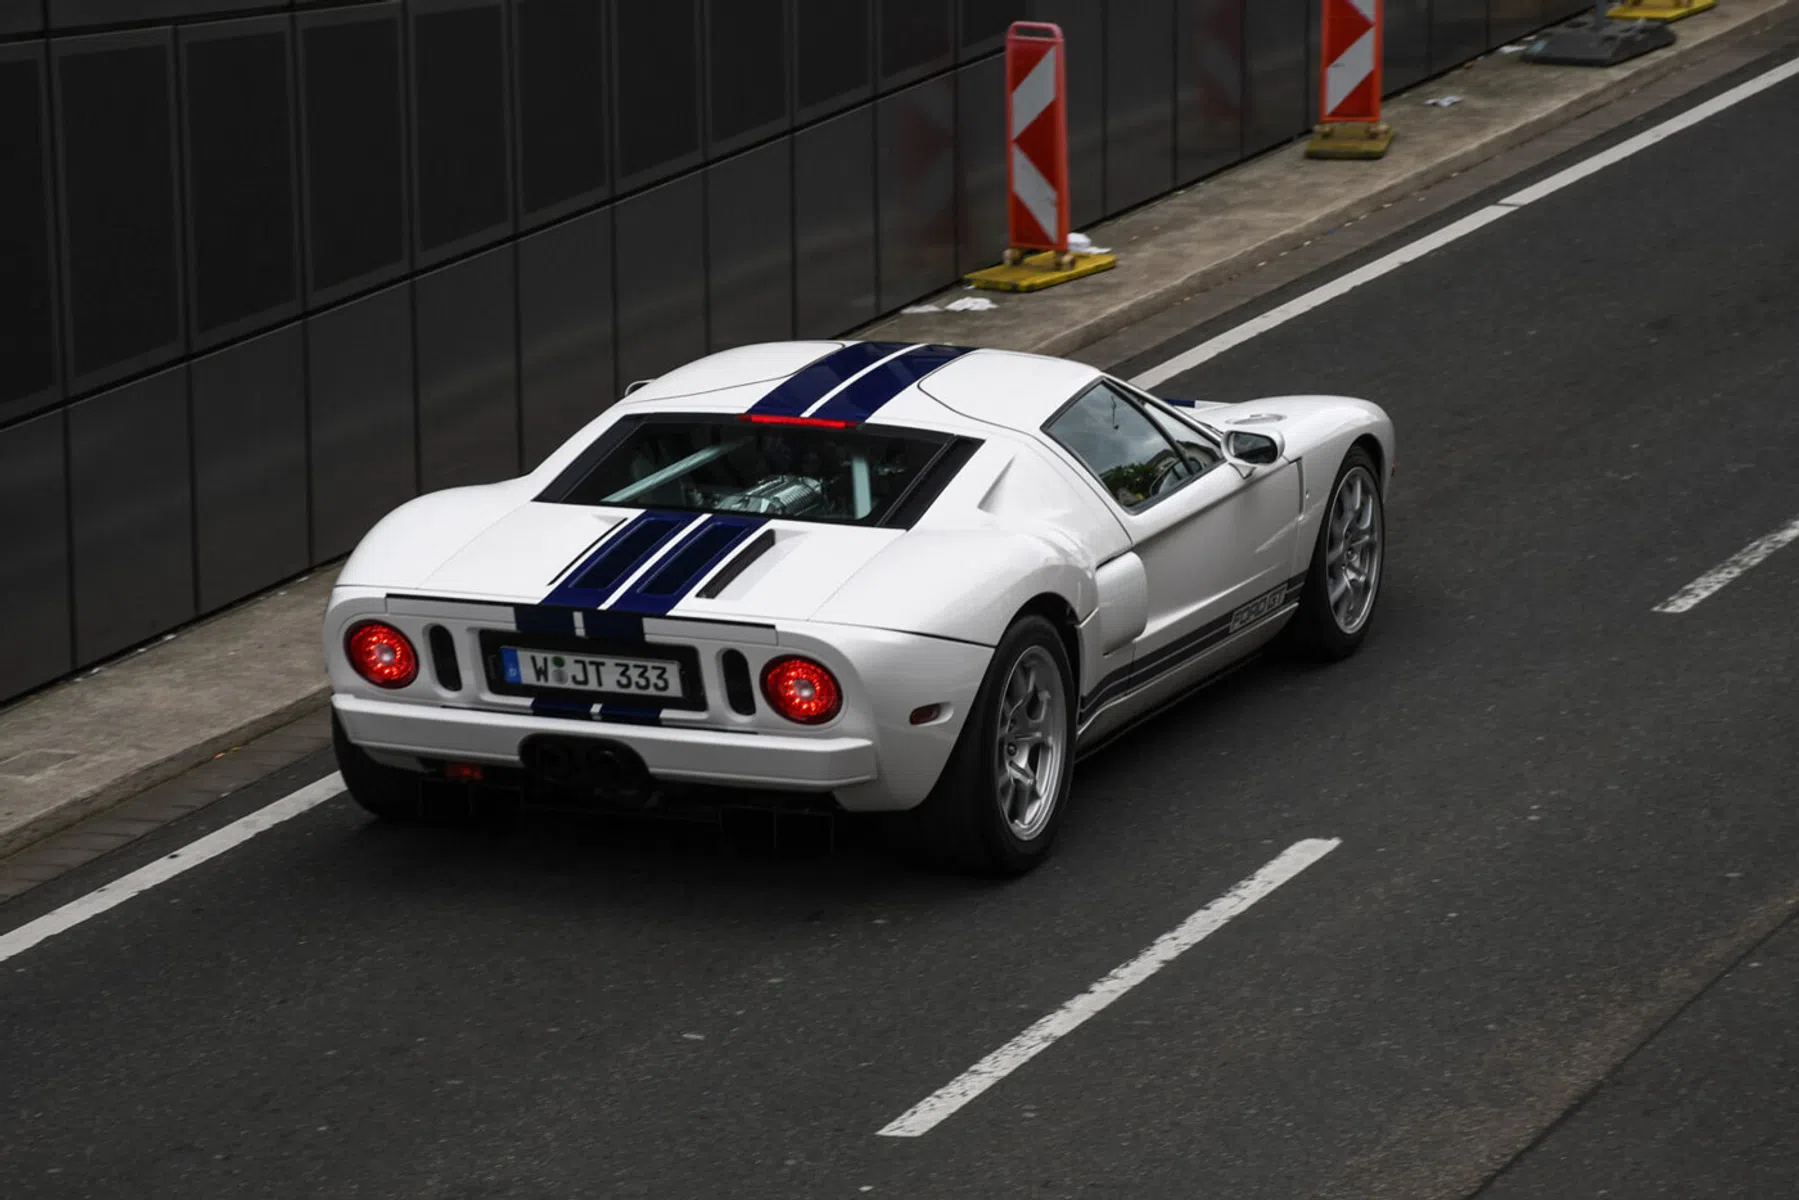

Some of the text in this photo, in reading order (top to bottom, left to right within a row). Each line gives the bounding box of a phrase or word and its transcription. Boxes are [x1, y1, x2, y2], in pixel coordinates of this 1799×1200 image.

[530, 655, 669, 691] W JT 333
